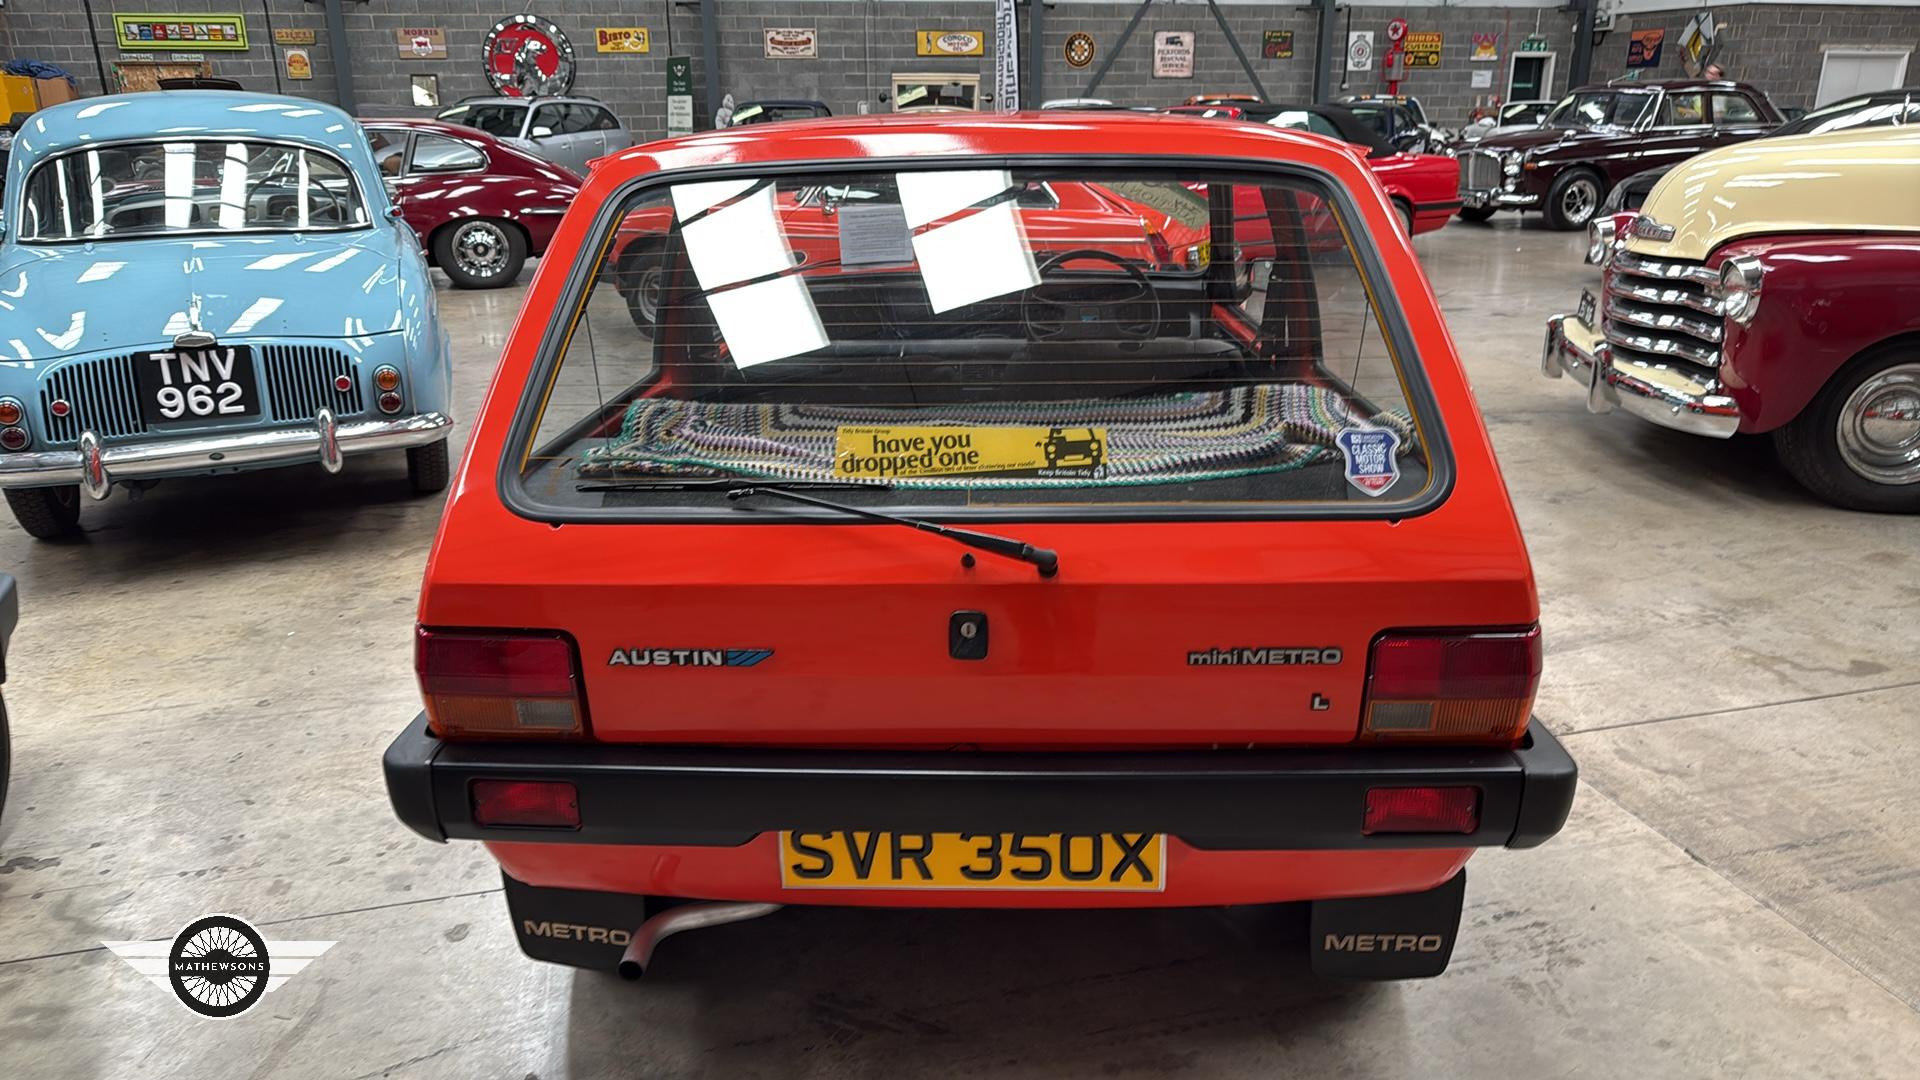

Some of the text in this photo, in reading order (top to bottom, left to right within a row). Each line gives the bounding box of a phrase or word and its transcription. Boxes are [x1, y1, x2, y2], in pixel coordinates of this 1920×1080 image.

[599, 30, 631, 45] BISTO
[149, 348, 236, 386] TNV
[156, 381, 246, 419] 962
[872, 433, 971, 455] have you
[1351, 442, 1387, 455] CLASSIC
[841, 448, 980, 476] dropped one
[1355, 454, 1386, 465] MOTOR
[1037, 468, 1091, 477] Keep Britain Tidy
[1358, 463, 1384, 474] SHOW
[608, 649, 723, 666] AUSTIN
[1312, 695, 1329, 710] L
[791, 831, 1154, 883] SVR 350X
[523, 919, 632, 946] METRO
[1324, 934, 1442, 952] METRO
